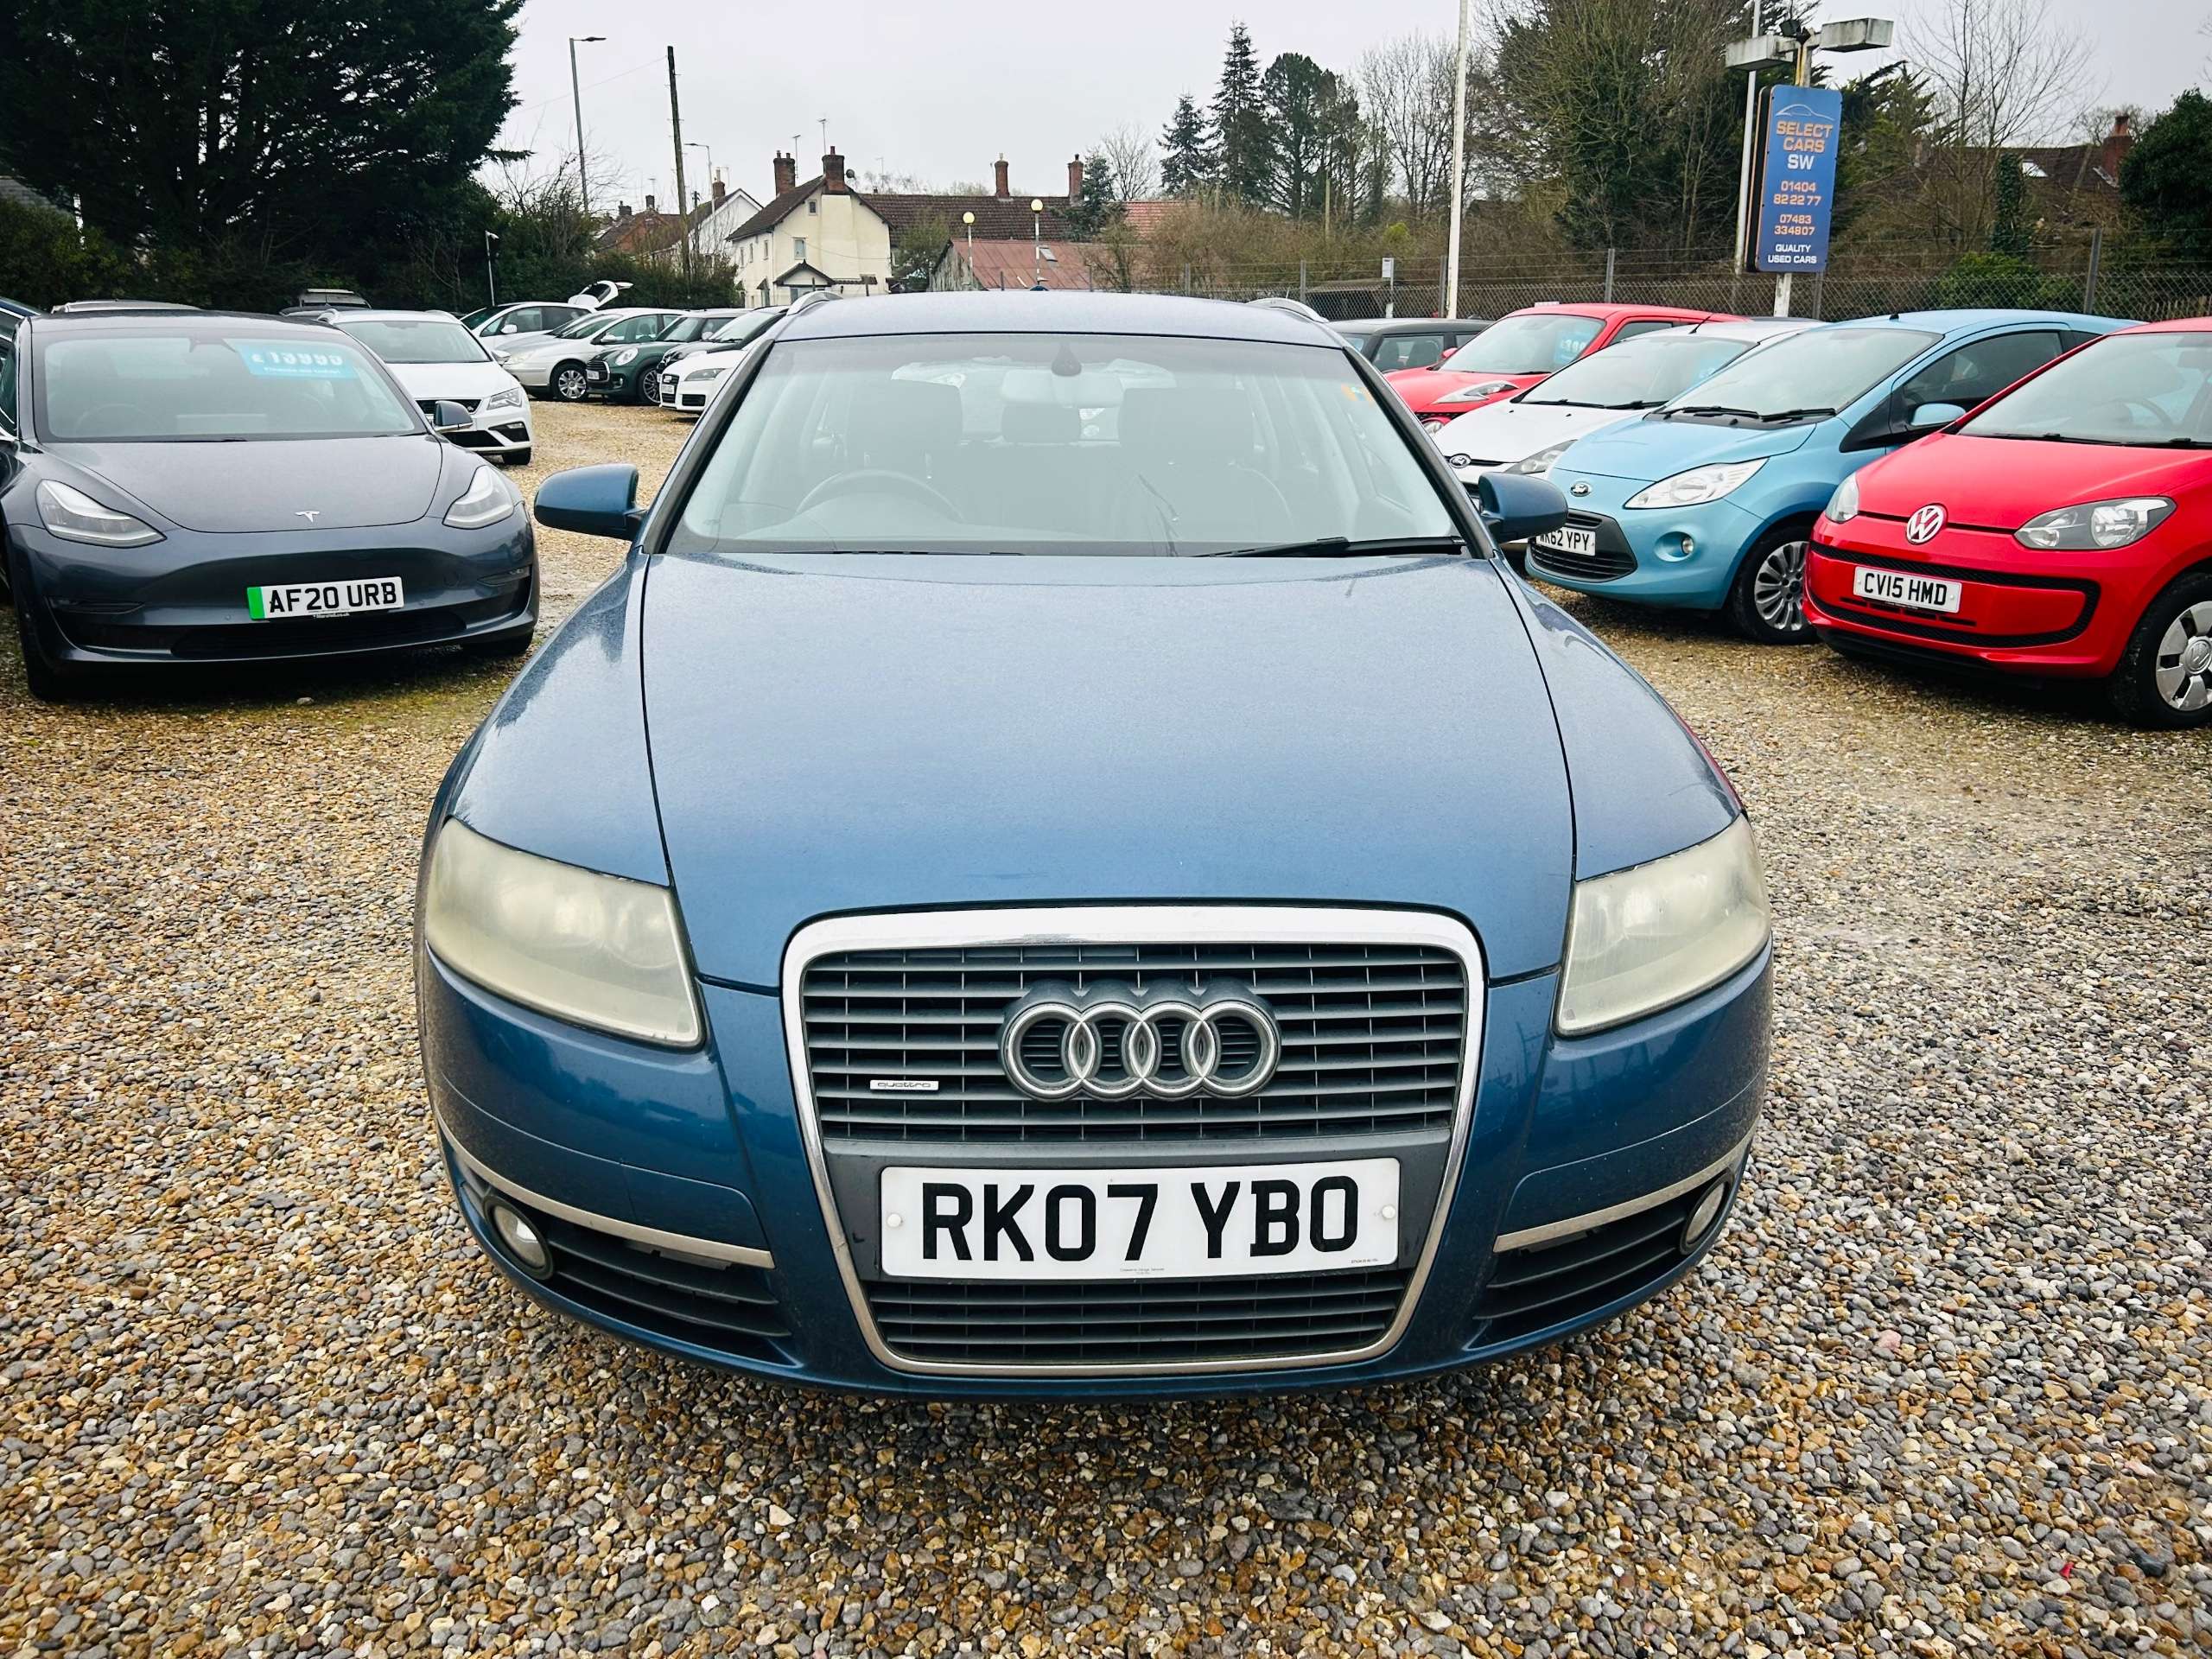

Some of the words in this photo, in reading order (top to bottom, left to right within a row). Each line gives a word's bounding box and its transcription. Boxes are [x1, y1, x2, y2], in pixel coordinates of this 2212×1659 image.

[1776, 120, 1834, 138] SELECT
[1783, 137, 1826, 153] CARS
[1787, 153, 1815, 170] SW
[1780, 180, 1816, 193] 01404
[1779, 213, 1812, 224] 07483
[1774, 226, 1816, 235] 334807
[1775, 244, 1812, 252] QUALITY
[1767, 254, 1792, 264] USED
[1793, 255, 1817, 264] CARS
[1566, 531, 1590, 551] YPY
[1864, 572, 1904, 598] CV15
[1908, 579, 1948, 606] HMD
[270, 586, 340, 613] AF20
[346, 582, 397, 607] URB
[922, 1182, 1159, 1262] RK07
[1191, 1175, 1359, 1259] YBO
